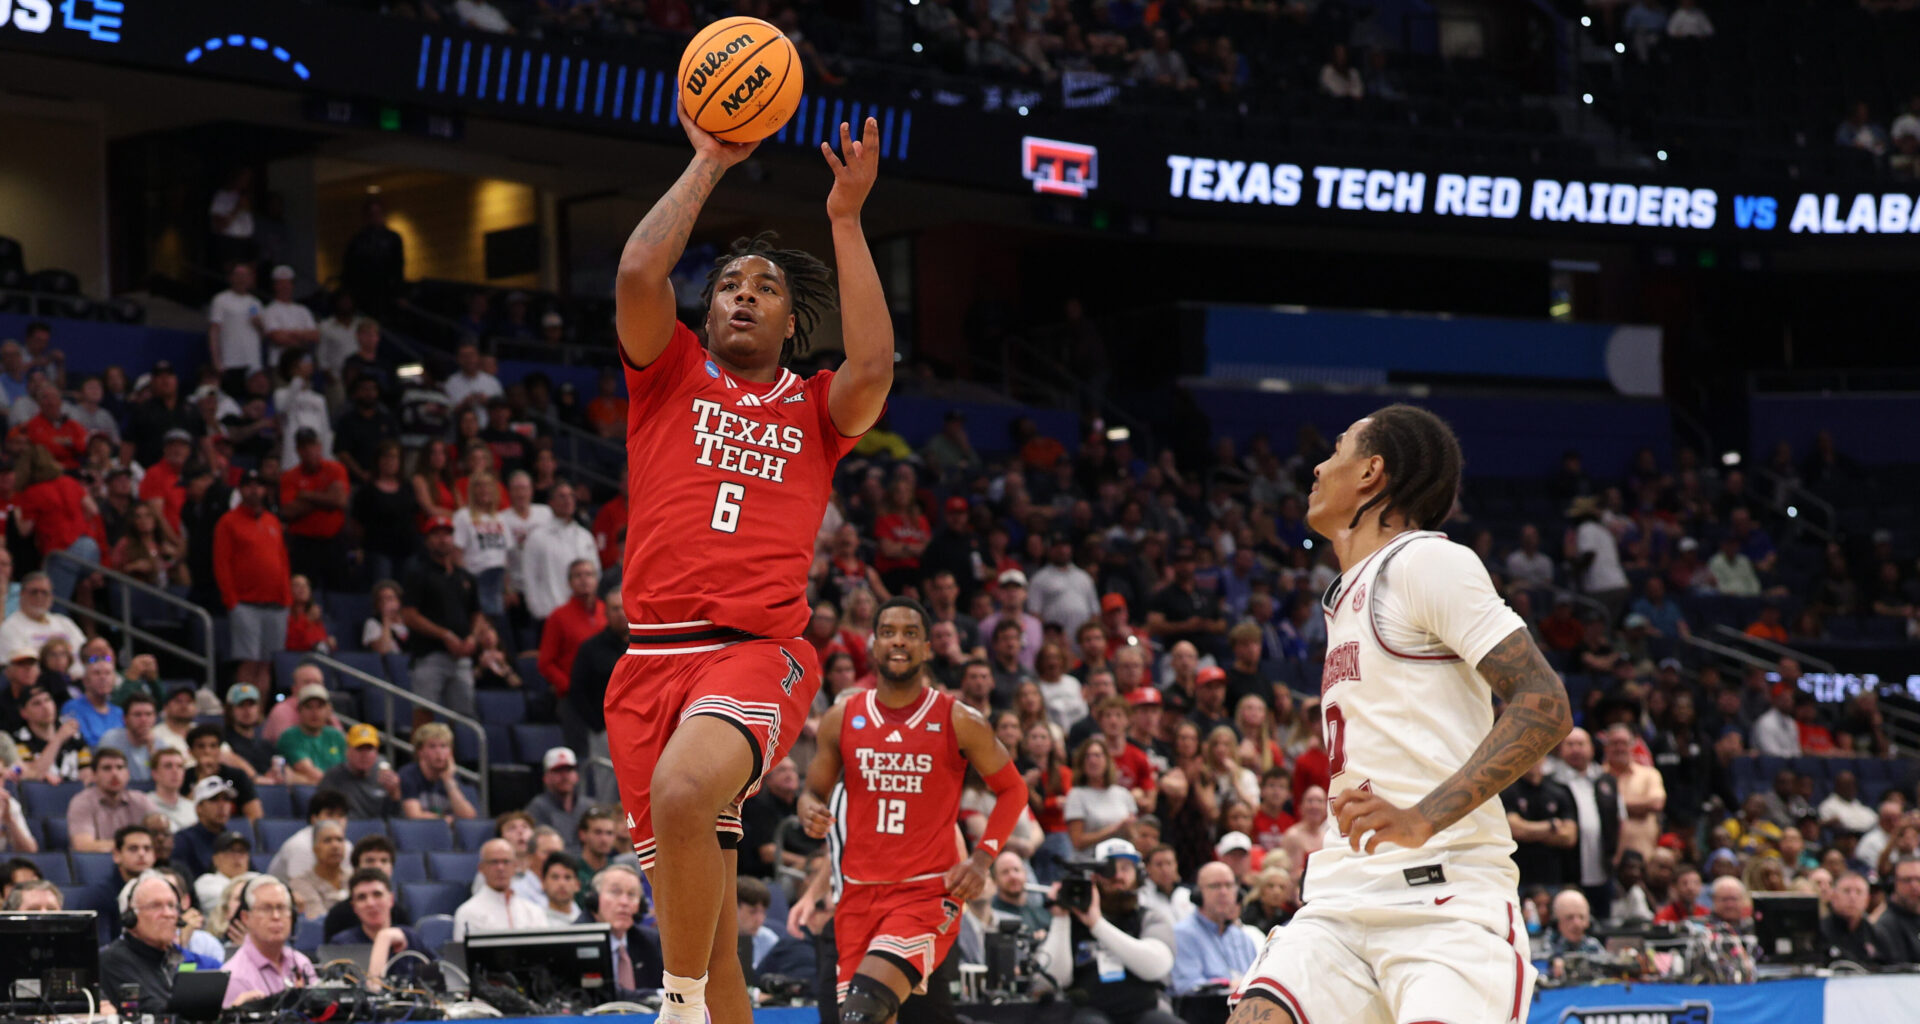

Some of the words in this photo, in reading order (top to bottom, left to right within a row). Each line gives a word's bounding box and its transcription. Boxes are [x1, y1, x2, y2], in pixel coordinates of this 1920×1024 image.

[0, 0, 53, 34] S
[686, 33, 755, 96] Wilson
[721, 64, 772, 116] NCAA
[1167, 154, 1304, 206] TEXAS
[1313, 166, 1427, 213] TECH
[1434, 173, 1522, 219] RED
[1529, 179, 1718, 229] RAIDERS
[1733, 194, 1779, 231] VS
[691, 397, 804, 455] TEXAS
[694, 431, 787, 484] TECH
[711, 481, 746, 534] 6
[855, 747, 933, 774] TEXAS
[862, 769, 924, 794] TECH
[876, 798, 907, 836] 12
